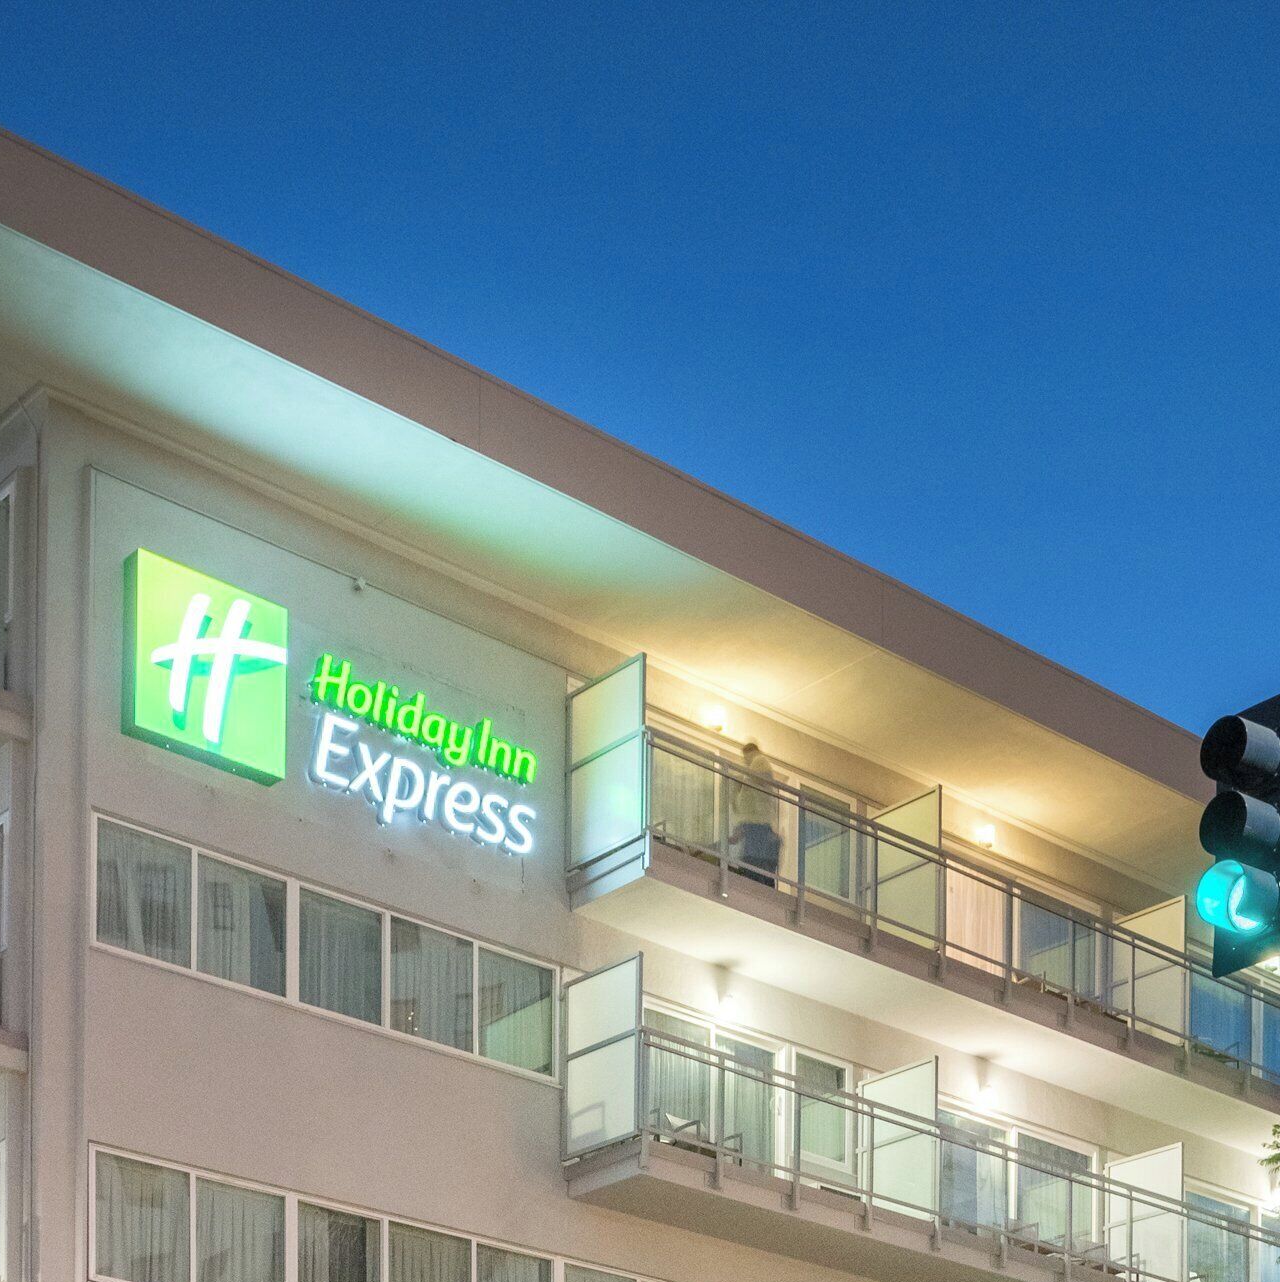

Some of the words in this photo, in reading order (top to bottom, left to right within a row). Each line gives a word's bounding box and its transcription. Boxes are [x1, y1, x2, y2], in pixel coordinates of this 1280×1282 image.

[314, 653, 474, 767] Holiday
[477, 717, 538, 784] Inn
[316, 713, 536, 855] Express
